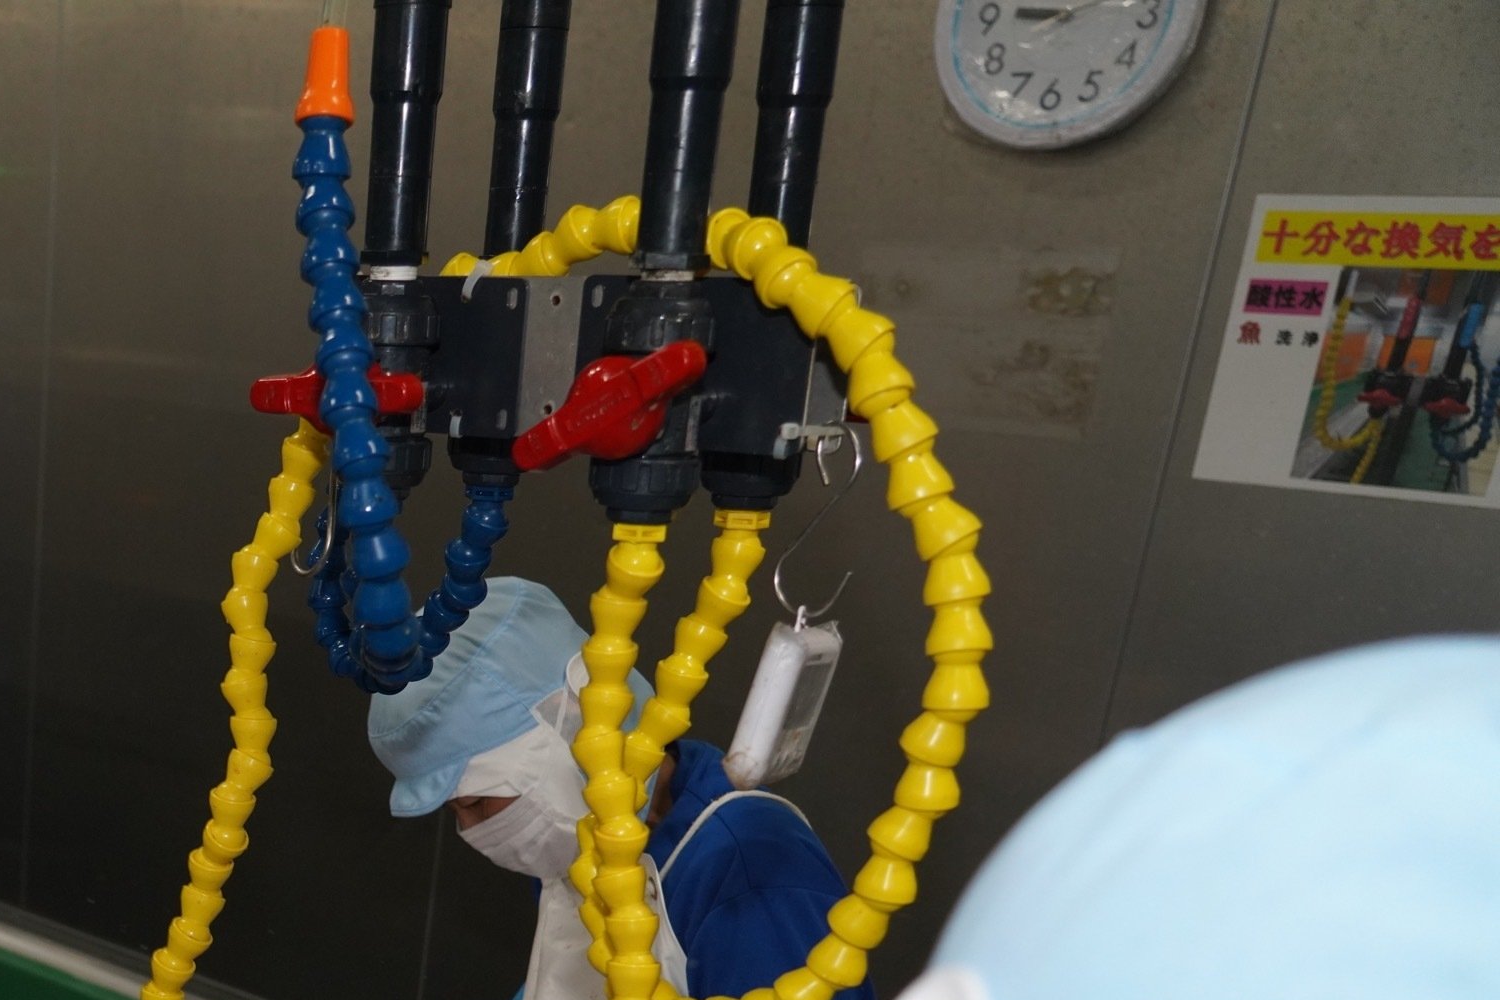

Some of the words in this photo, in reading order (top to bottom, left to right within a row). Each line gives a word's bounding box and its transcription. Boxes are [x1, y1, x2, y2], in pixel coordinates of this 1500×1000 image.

[978, 2, 1001, 37] 9
[1135, 0, 1159, 31] 3
[984, 43, 1006, 76] 8
[1114, 39, 1138, 70] 4
[1010, 72, 1034, 98] 7
[1039, 77, 1062, 111] 6
[1077, 69, 1103, 103] 5
[1262, 218, 1500, 262] 十分な換気を
